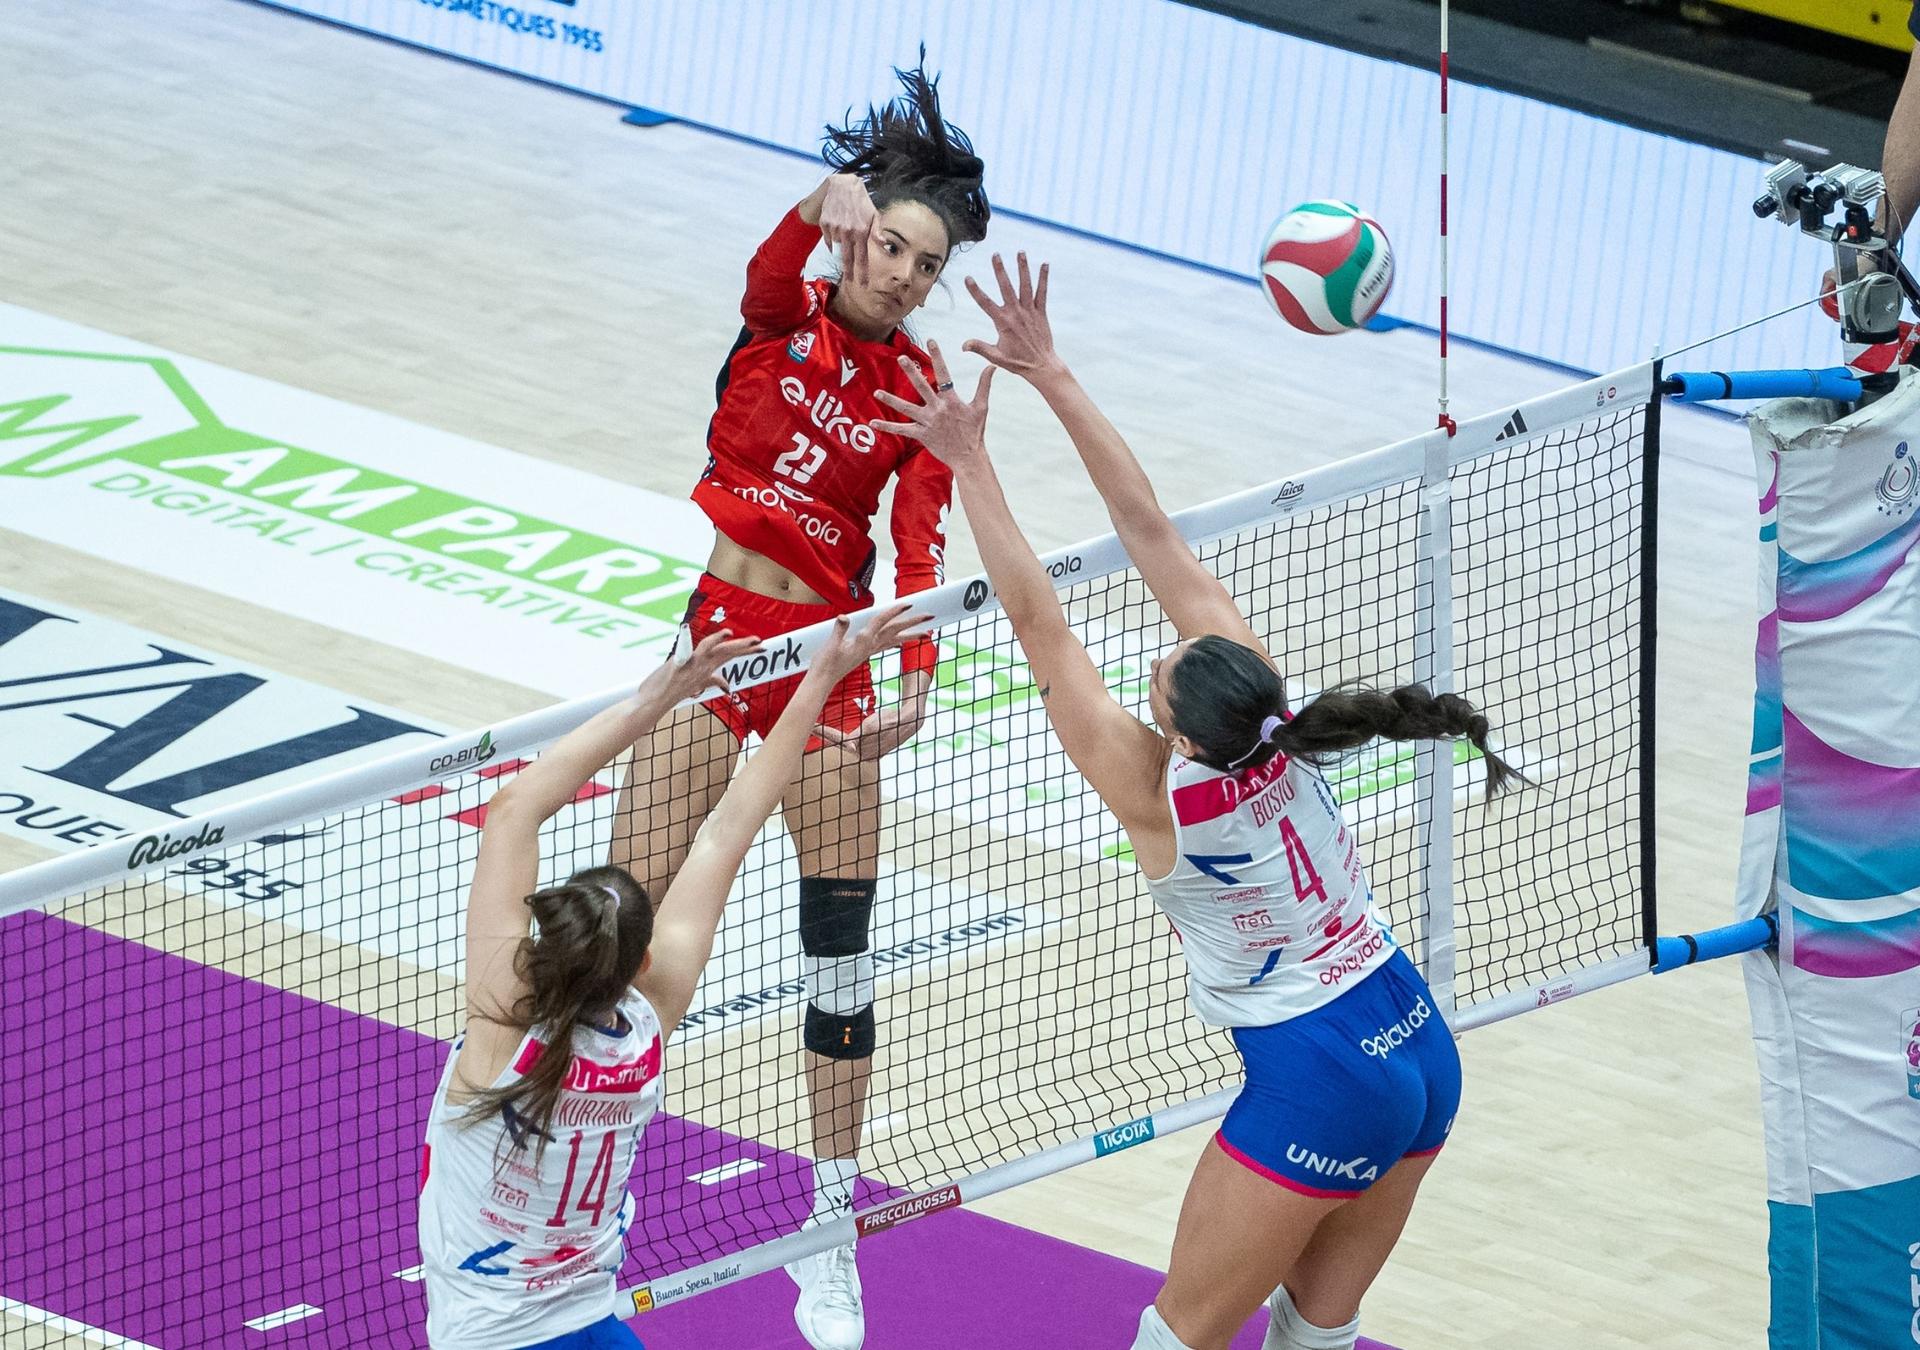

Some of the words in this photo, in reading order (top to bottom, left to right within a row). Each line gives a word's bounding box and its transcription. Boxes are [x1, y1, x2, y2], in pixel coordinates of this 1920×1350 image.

[772, 432, 827, 484] 23
[90, 472, 311, 548] DIGITAL
[354, 551, 640, 638] CREATIVE
[721, 637, 803, 686] work
[1250, 773, 1295, 828] BOSIO
[128, 822, 226, 870] Ricola
[1278, 815, 1328, 903] 4
[546, 1130, 616, 1227] 14
[1286, 1143, 1379, 1182] UNIKA
[863, 1188, 957, 1230] FRECCIAROSSA
[655, 1285, 684, 1303] Buona
[685, 1273, 713, 1294] Spesa,
[713, 1263, 742, 1283] Italia!
